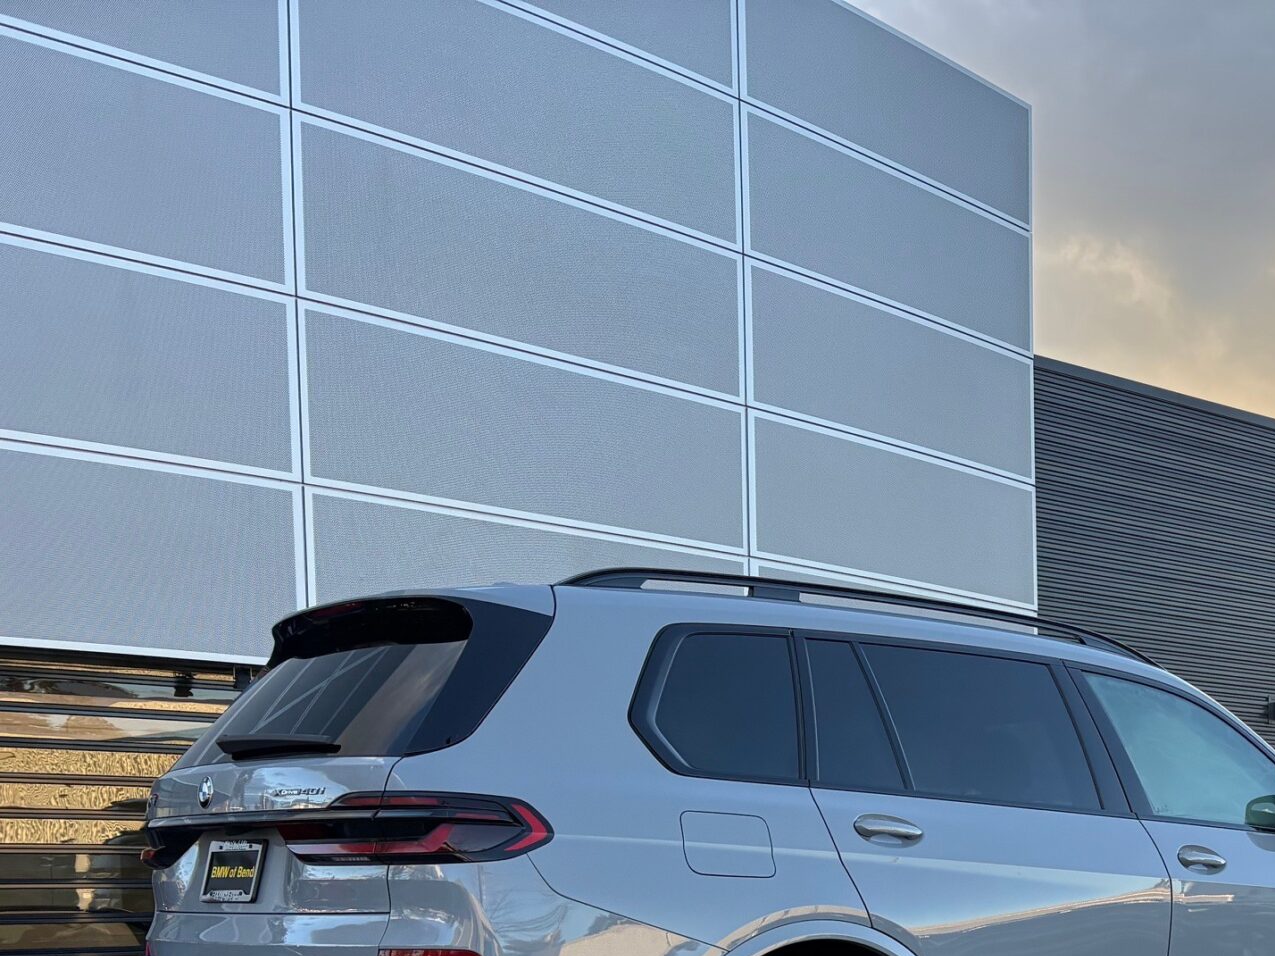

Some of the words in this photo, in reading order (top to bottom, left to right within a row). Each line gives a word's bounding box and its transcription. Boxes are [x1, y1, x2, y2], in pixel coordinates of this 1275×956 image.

[211, 866, 230, 878] BMW
[229, 866, 237, 878] of
[237, 866, 254, 878] Bend
